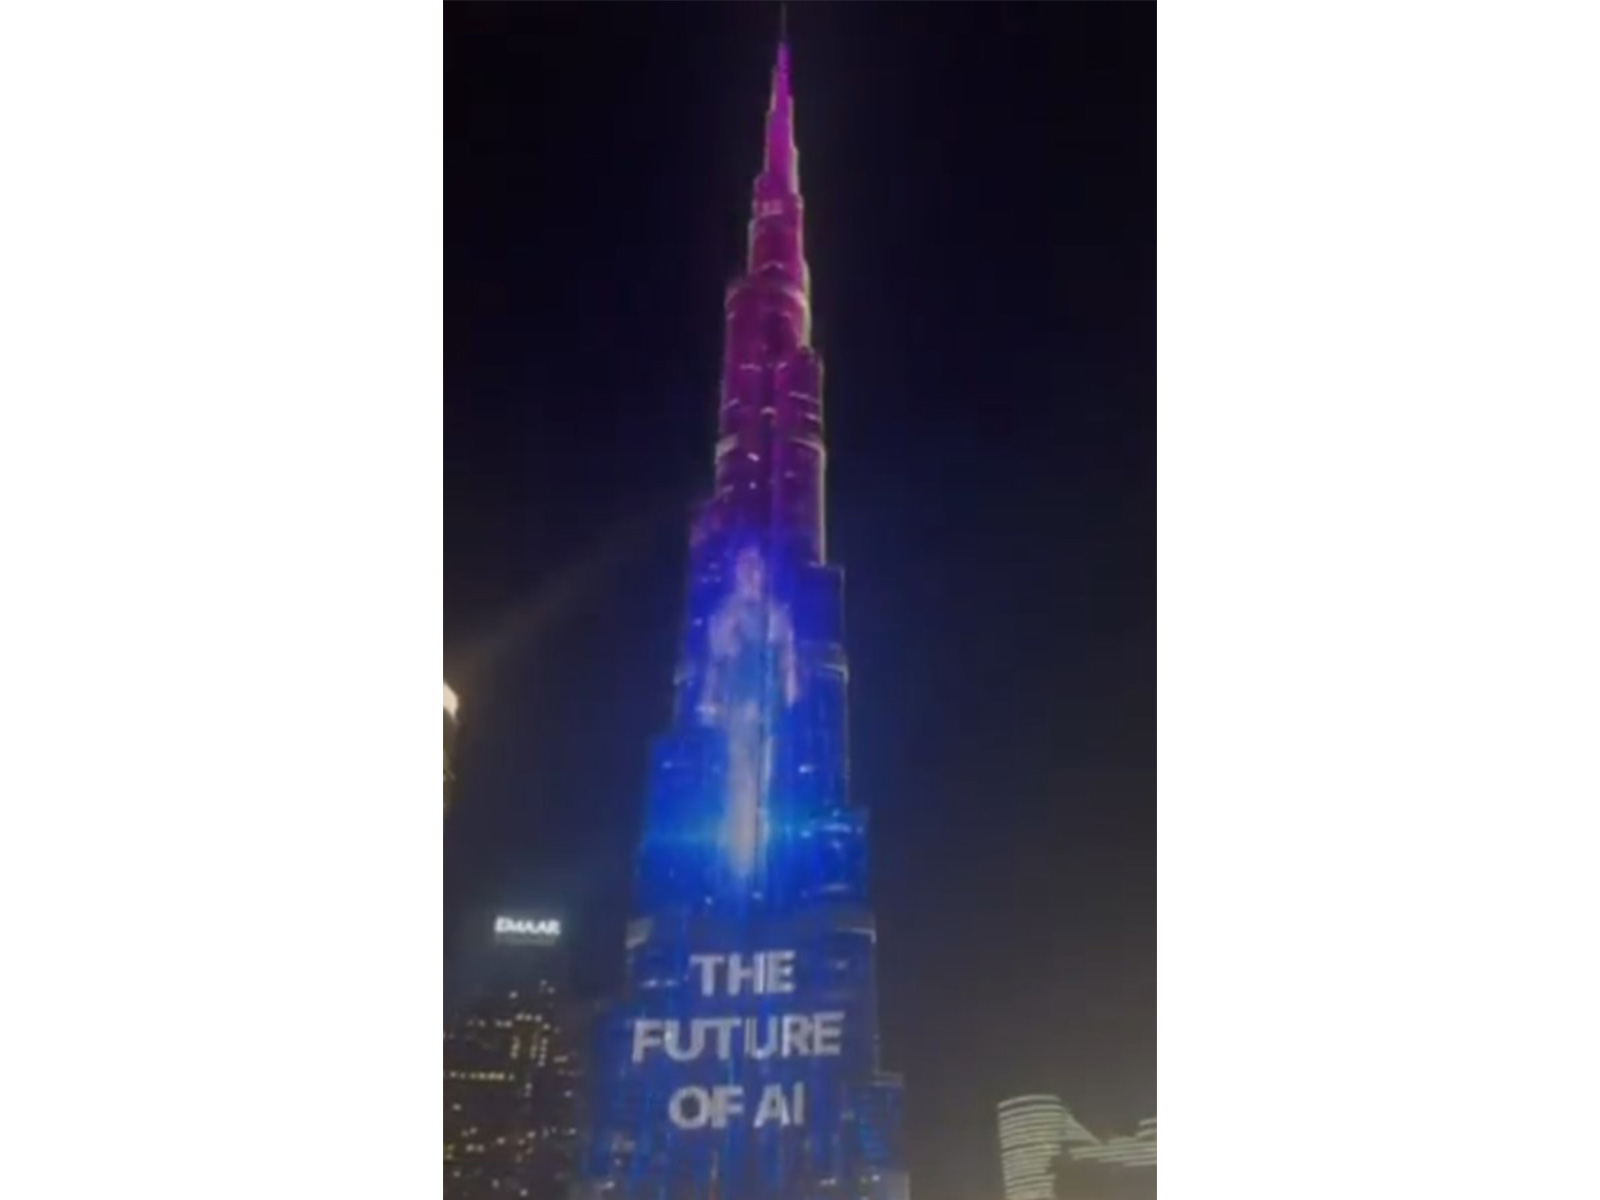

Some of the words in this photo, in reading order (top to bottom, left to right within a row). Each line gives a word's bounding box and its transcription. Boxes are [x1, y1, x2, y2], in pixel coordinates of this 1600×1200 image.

[495, 916, 561, 935] EMAAR
[690, 950, 796, 997] THE
[631, 1011, 845, 1063] FUTURE
[668, 1086, 744, 1129] OF
[753, 1082, 806, 1128] AI
